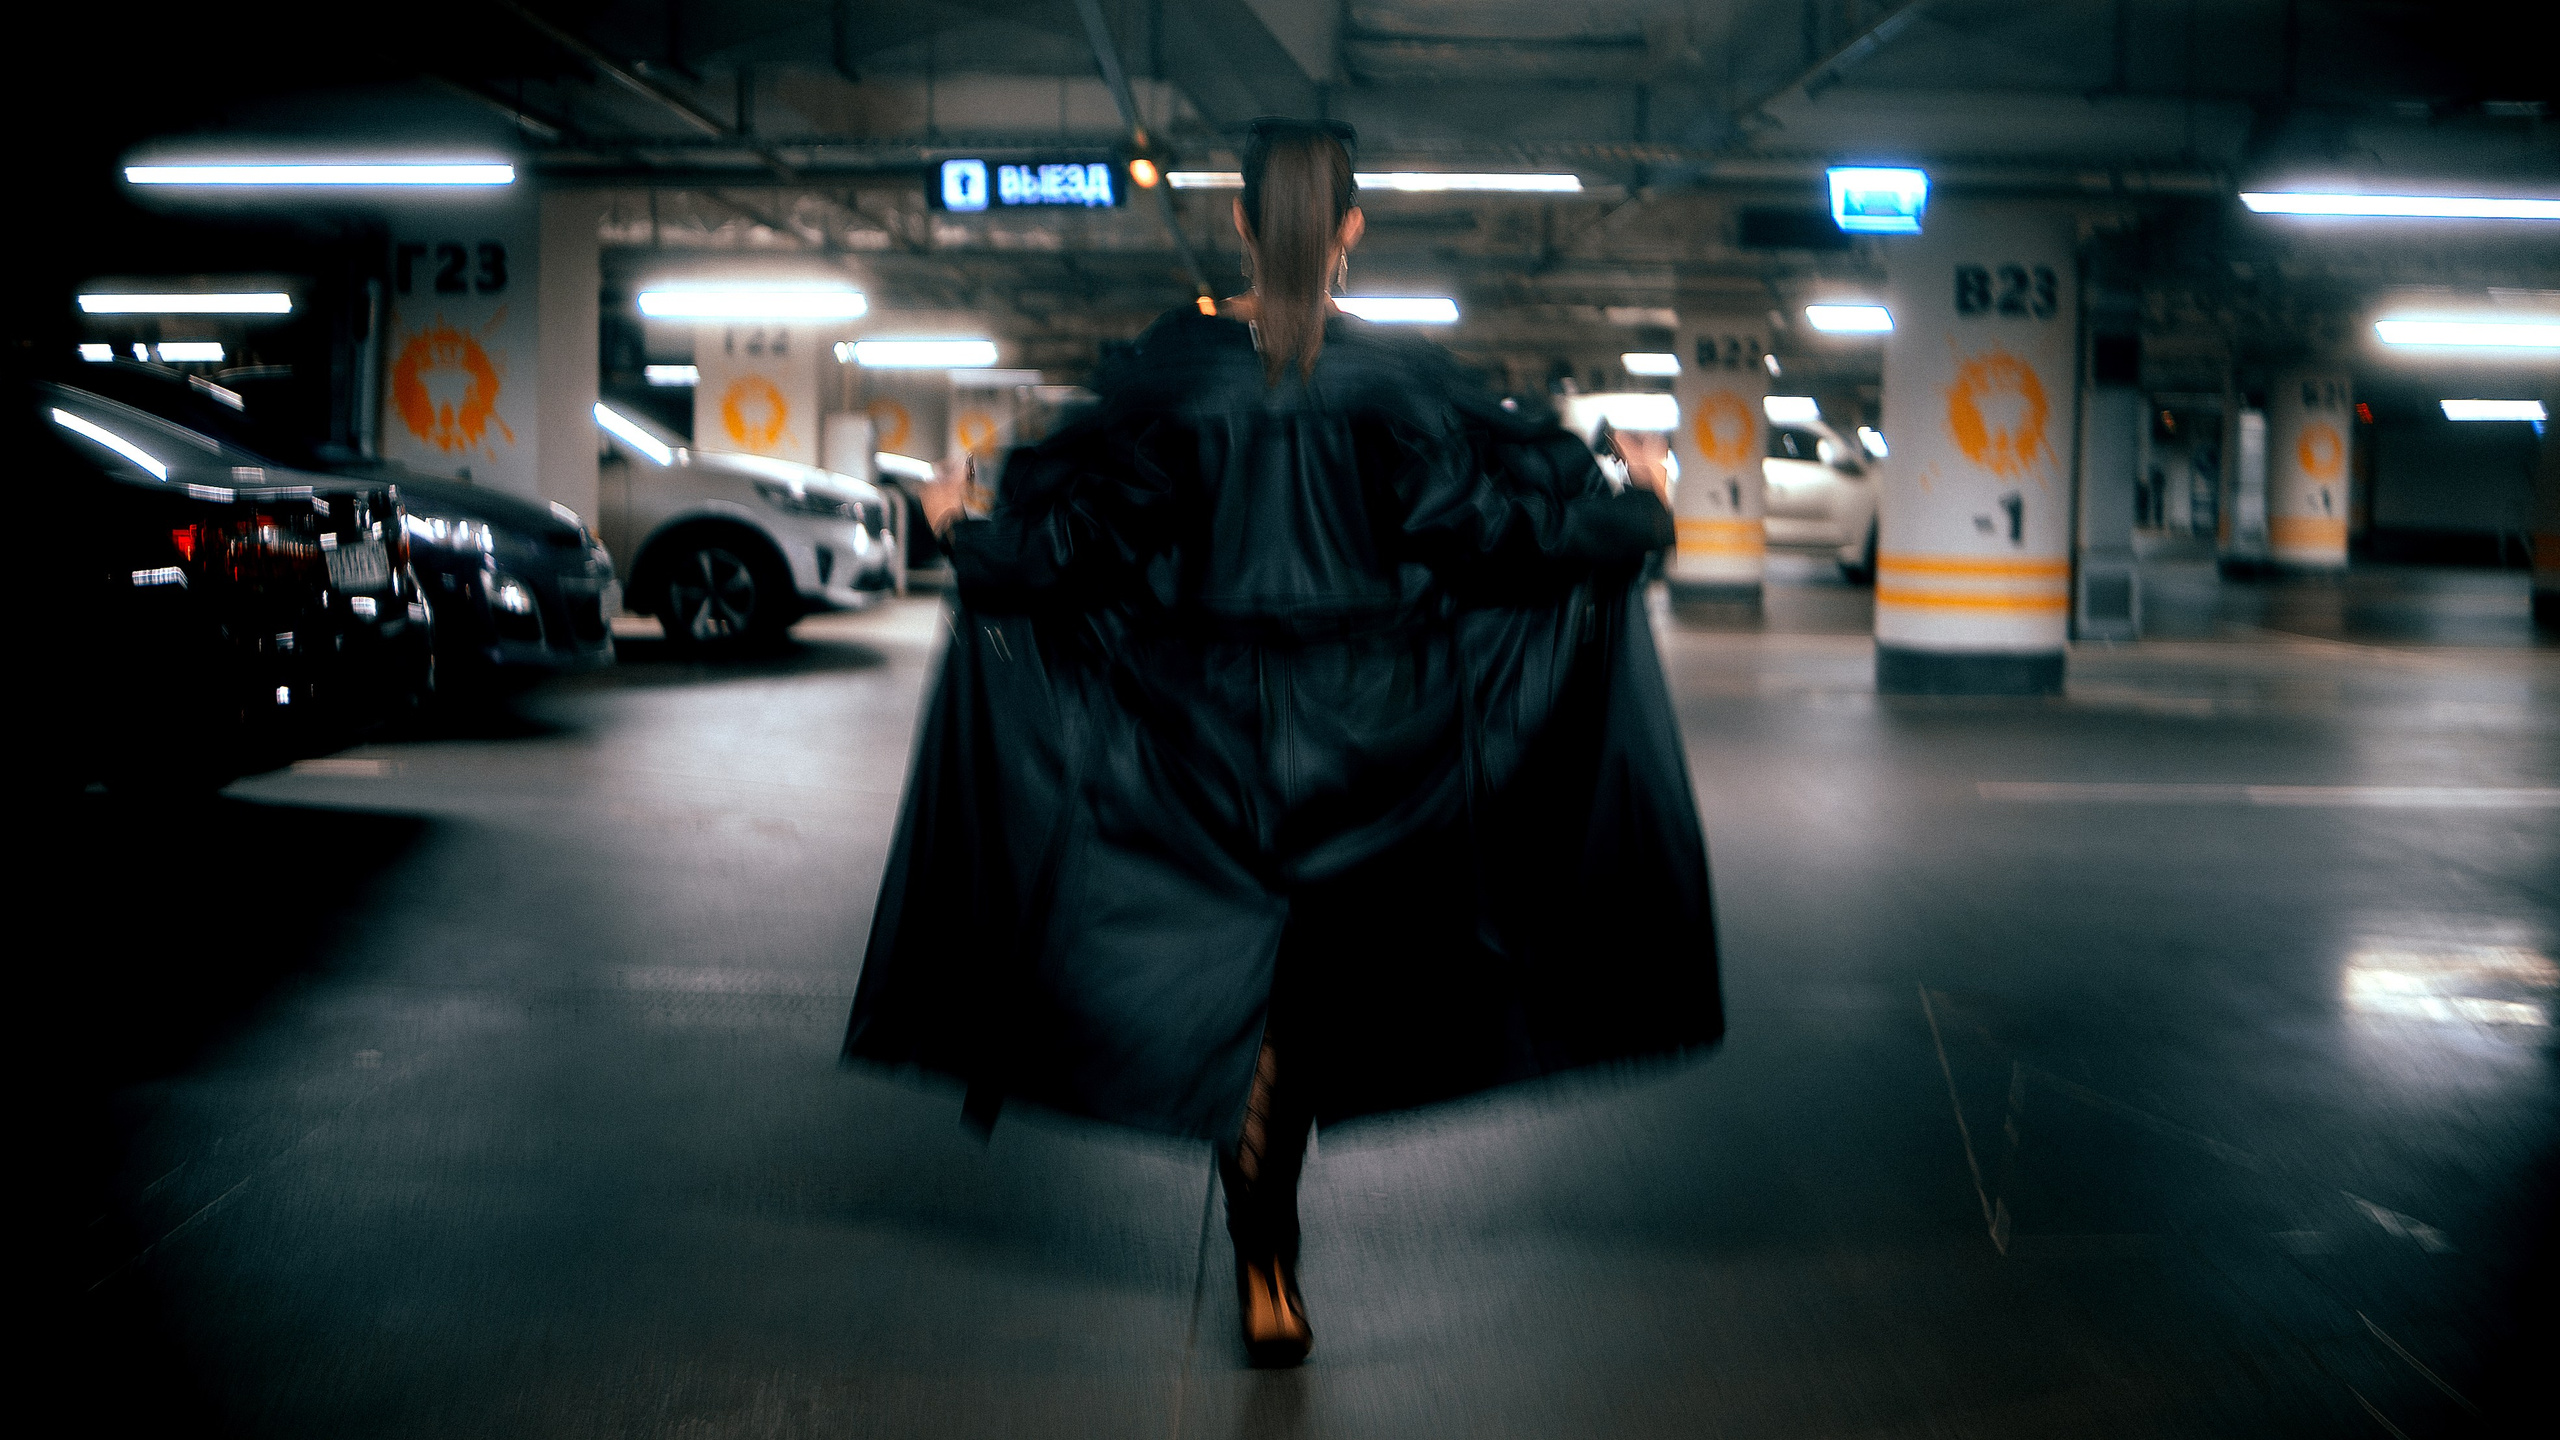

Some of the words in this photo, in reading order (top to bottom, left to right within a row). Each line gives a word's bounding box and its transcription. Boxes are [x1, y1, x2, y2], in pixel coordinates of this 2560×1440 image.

[997, 162, 1114, 207] ВЫЕЗД
[397, 242, 508, 293] Г23
[1955, 264, 2058, 318] В23
